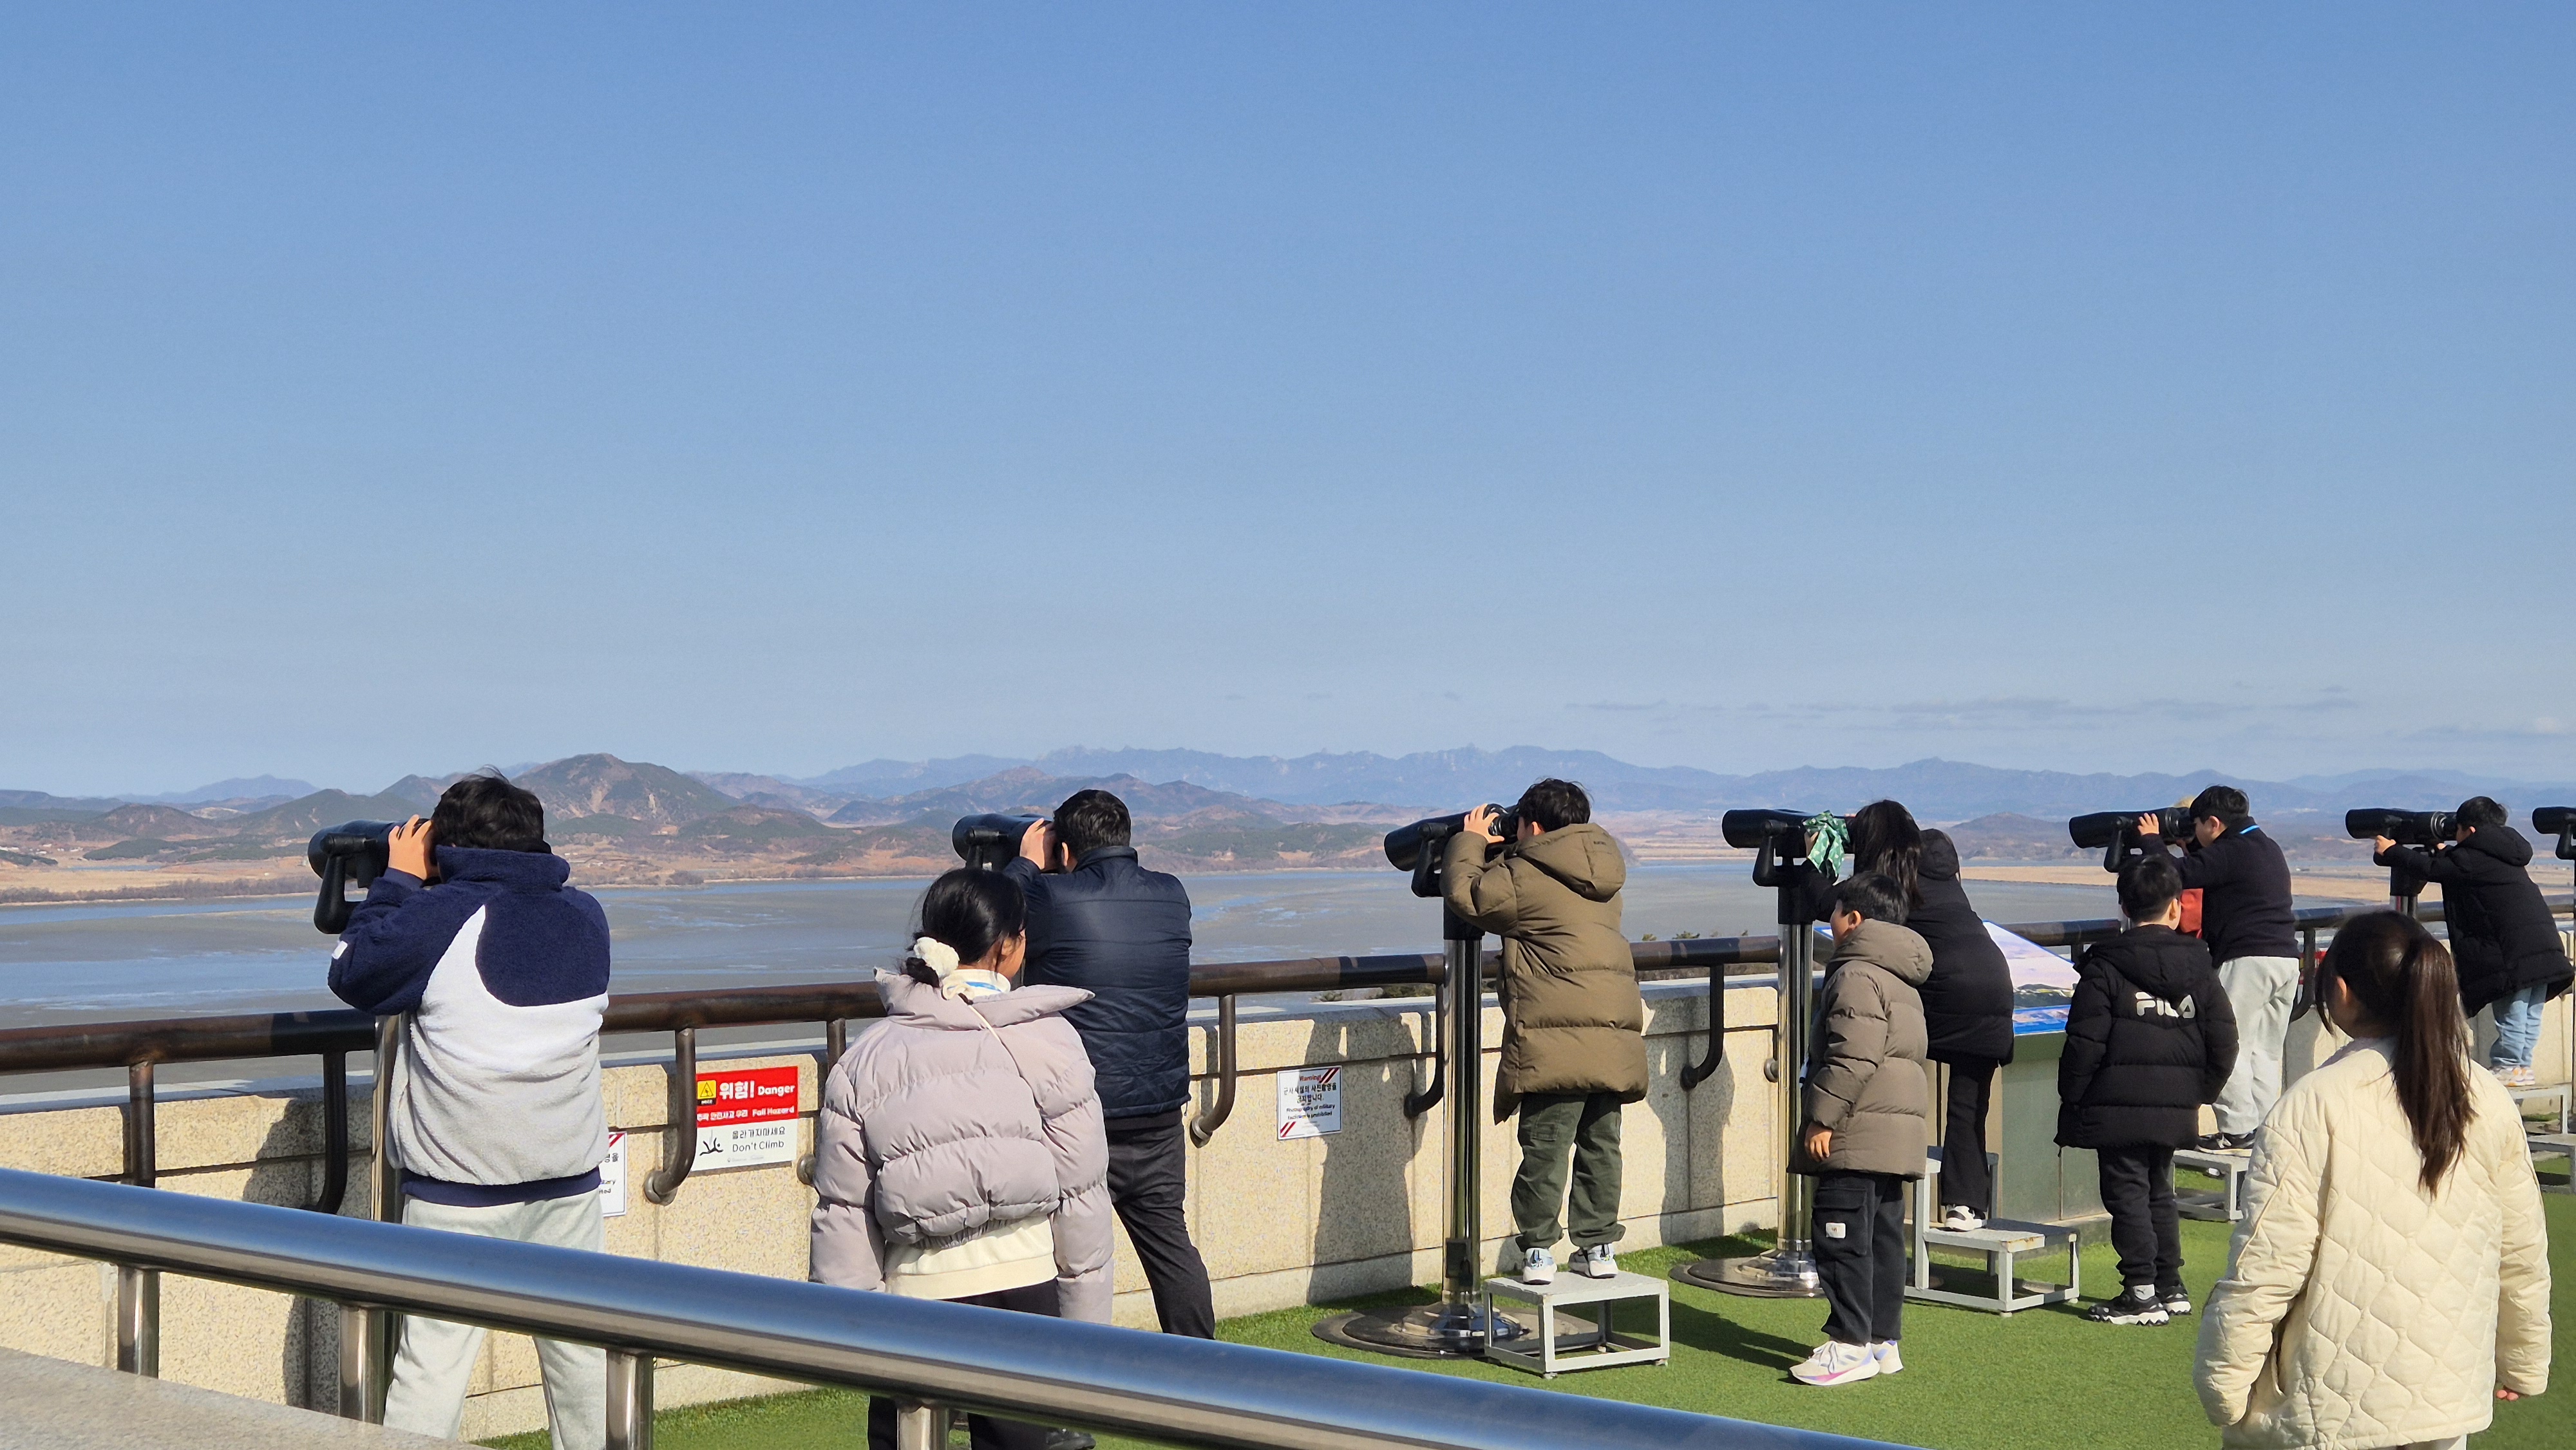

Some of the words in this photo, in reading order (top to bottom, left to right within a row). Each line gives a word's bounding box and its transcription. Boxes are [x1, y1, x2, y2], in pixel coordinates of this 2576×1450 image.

[2136, 992, 2195, 1019] FILA
[719, 1080, 754, 1100] 위험!
[758, 1086, 795, 1097] Danger
[752, 1109, 766, 1117] Fall
[767, 1106, 795, 1115] Hazard
[732, 1142, 757, 1153] Don't
[759, 1141, 784, 1150] Climb
